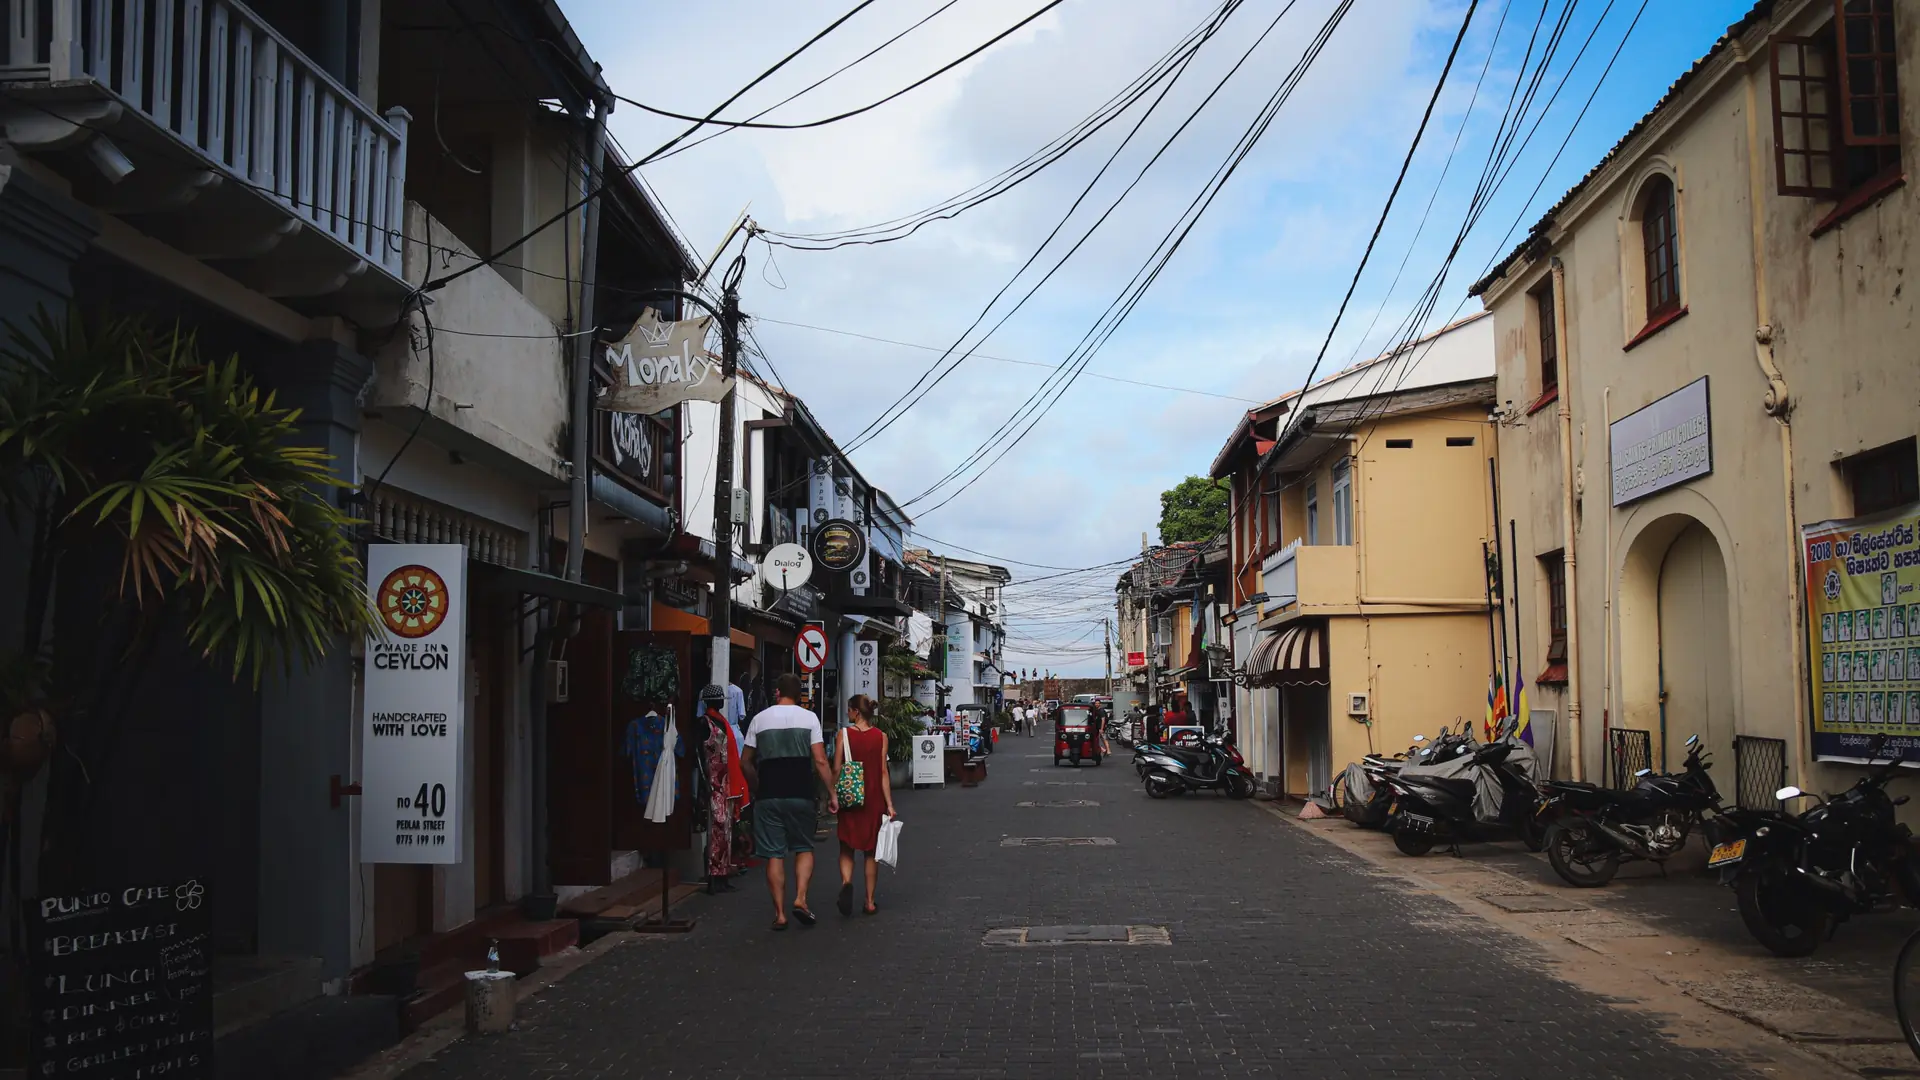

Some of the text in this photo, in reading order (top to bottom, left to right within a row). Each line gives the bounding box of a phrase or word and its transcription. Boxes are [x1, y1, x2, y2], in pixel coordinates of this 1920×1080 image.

[605, 339, 713, 391] Monaky
[1648, 428, 1677, 457] PRIMARY
[1677, 413, 1706, 444] COLLEGE
[1810, 541, 1832, 563] 2018
[384, 643, 438, 653] MADE IN
[374, 653, 448, 670] CEYLON
[857, 657, 874, 667] MY
[372, 712, 447, 722] HANDCRAFTED
[372, 723, 447, 737] WITH LOVE
[397, 782, 446, 818] no 40
[396, 820, 445, 831] PEDLAR STREET
[396, 834, 446, 845] 0775 199 199
[40, 886, 169, 918] PUNTO CAFE
[52, 922, 178, 956] BREAKFAST
[59, 966, 155, 994] LUNCH
[62, 990, 158, 1020] DINNER
[67, 1027, 107, 1045] RICE
